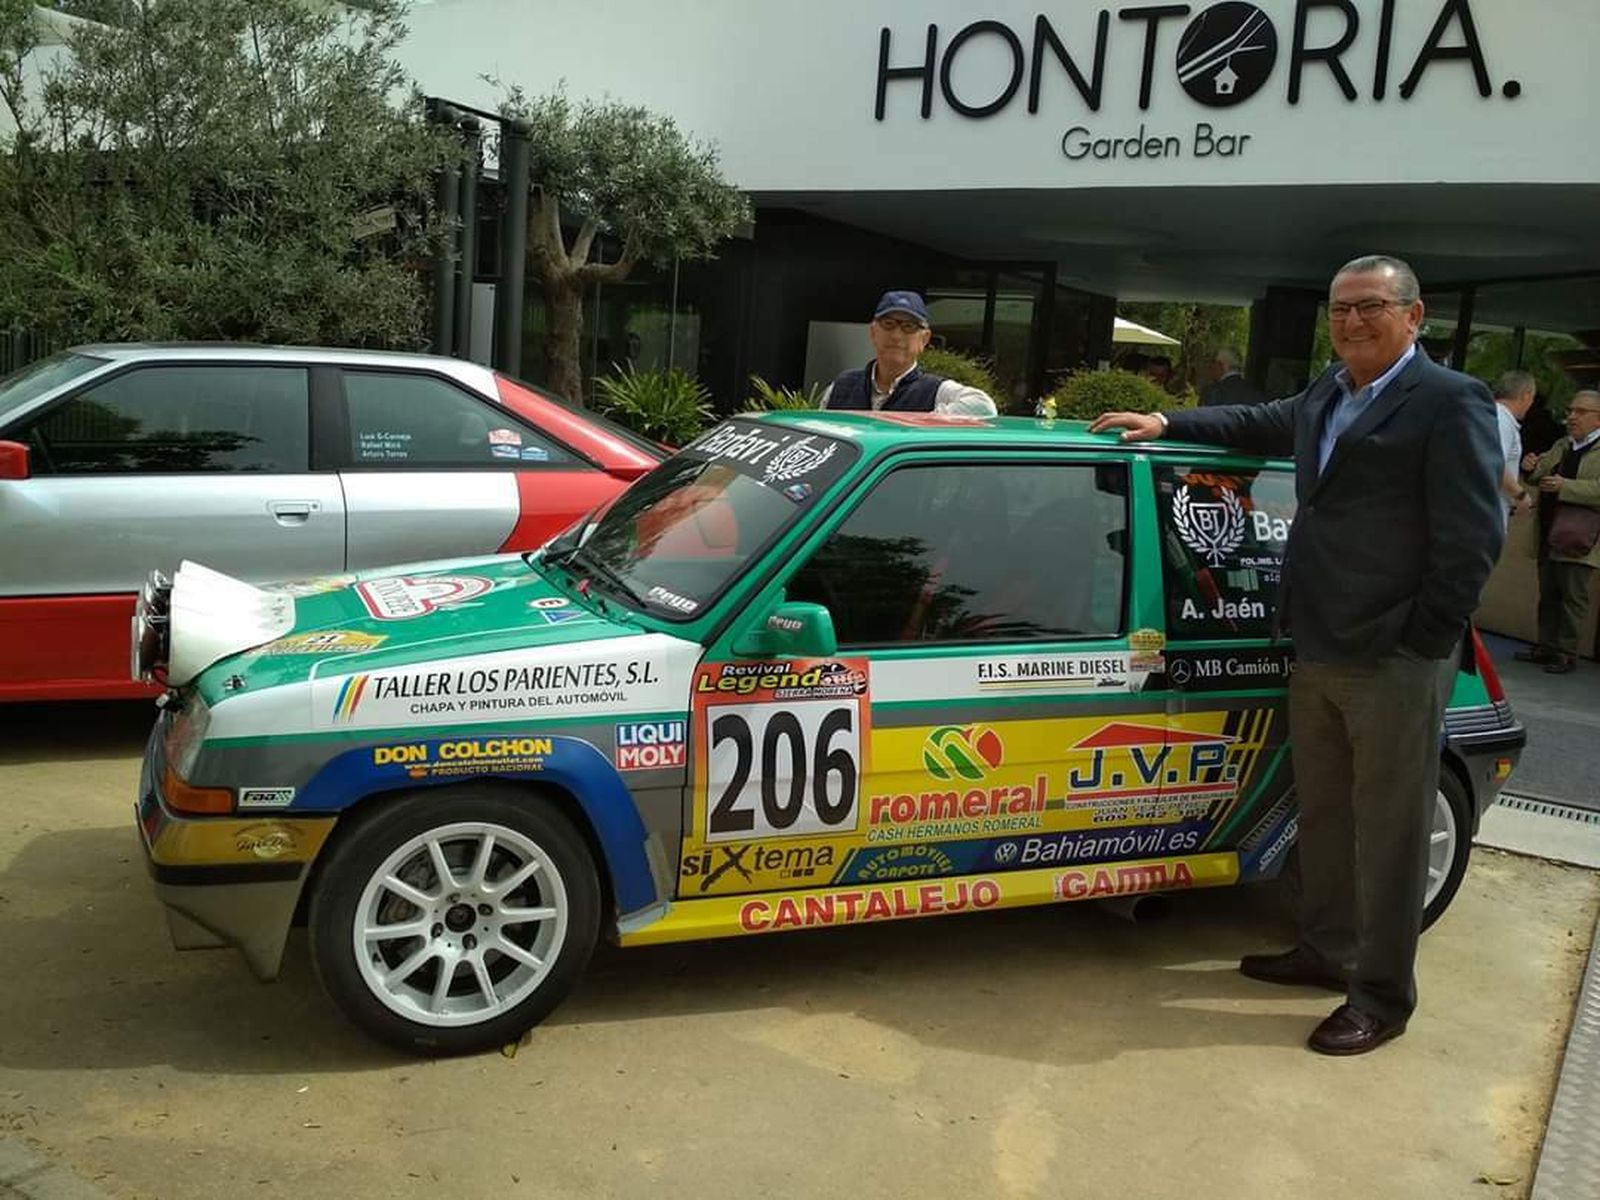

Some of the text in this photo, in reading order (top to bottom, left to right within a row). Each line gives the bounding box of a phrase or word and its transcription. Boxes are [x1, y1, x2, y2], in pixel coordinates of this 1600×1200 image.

[1061, 122, 1252, 161] Garden Bar
[1196, 509, 1220, 537] BJ
[1181, 596, 1266, 620] A. Jaén
[374, 660, 659, 700] TALLER LOS PARIENTES, S.L.
[722, 663, 792, 677] Revival
[978, 662, 1012, 678] F.I.S.
[1017, 660, 1075, 676] MARINE
[1079, 659, 1127, 674] DIESEL
[1195, 659, 1222, 678] MB
[1226, 657, 1280, 677] Camión
[410, 691, 628, 715] CHAPA Y PINTURA DEL AUTOMÓVIL
[618, 722, 683, 746] LIQUI
[374, 738, 552, 765] DON COLCHON
[618, 745, 685, 769] MOLY
[431, 763, 544, 777] PRODUCTO NACIONAL
[709, 707, 857, 834] 206
[1070, 742, 1240, 790] J.V.P.
[869, 774, 1048, 826] romeral
[867, 816, 1042, 843] CASH HERMANOS ROMERAL
[1020, 828, 1198, 865] Bahiamóvil.es
[738, 878, 1001, 933] CANTALEJO
